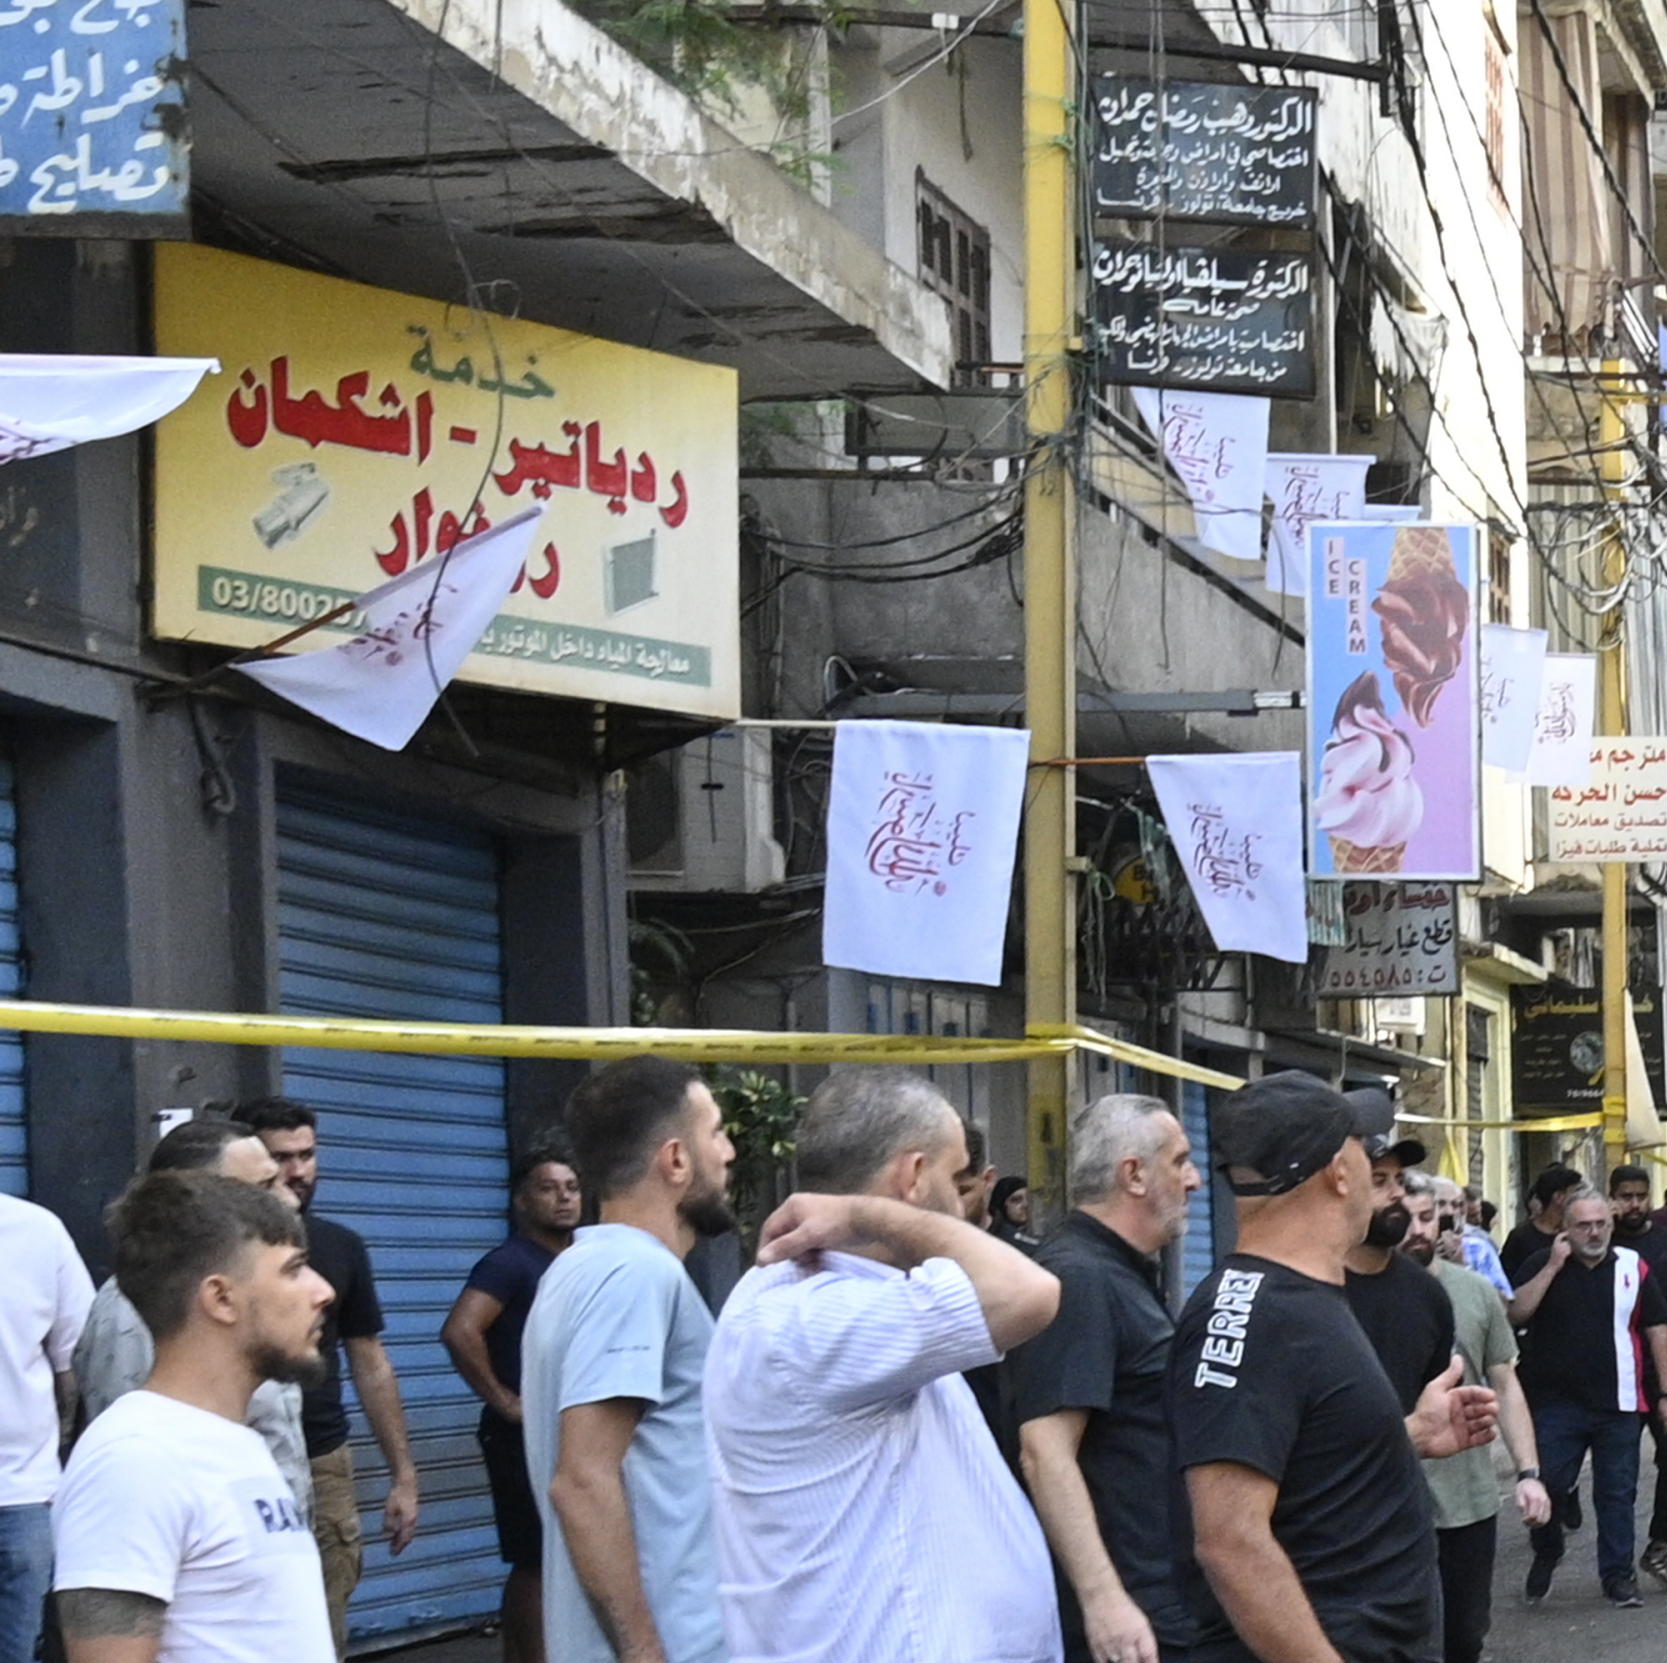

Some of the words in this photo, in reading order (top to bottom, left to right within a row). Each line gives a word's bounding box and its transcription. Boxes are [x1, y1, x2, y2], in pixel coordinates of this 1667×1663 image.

[27, 132, 170, 214] تصليح
[406, 324, 556, 400] خدمة
[226, 354, 435, 468] اشكمان
[491, 418, 690, 530] ردياتير
[1328, 539, 1341, 595] ICE
[1348, 559, 1367, 653] CREAM
[1605, 743, 1667, 773] مترجم
[1623, 783, 1667, 806] حسن
